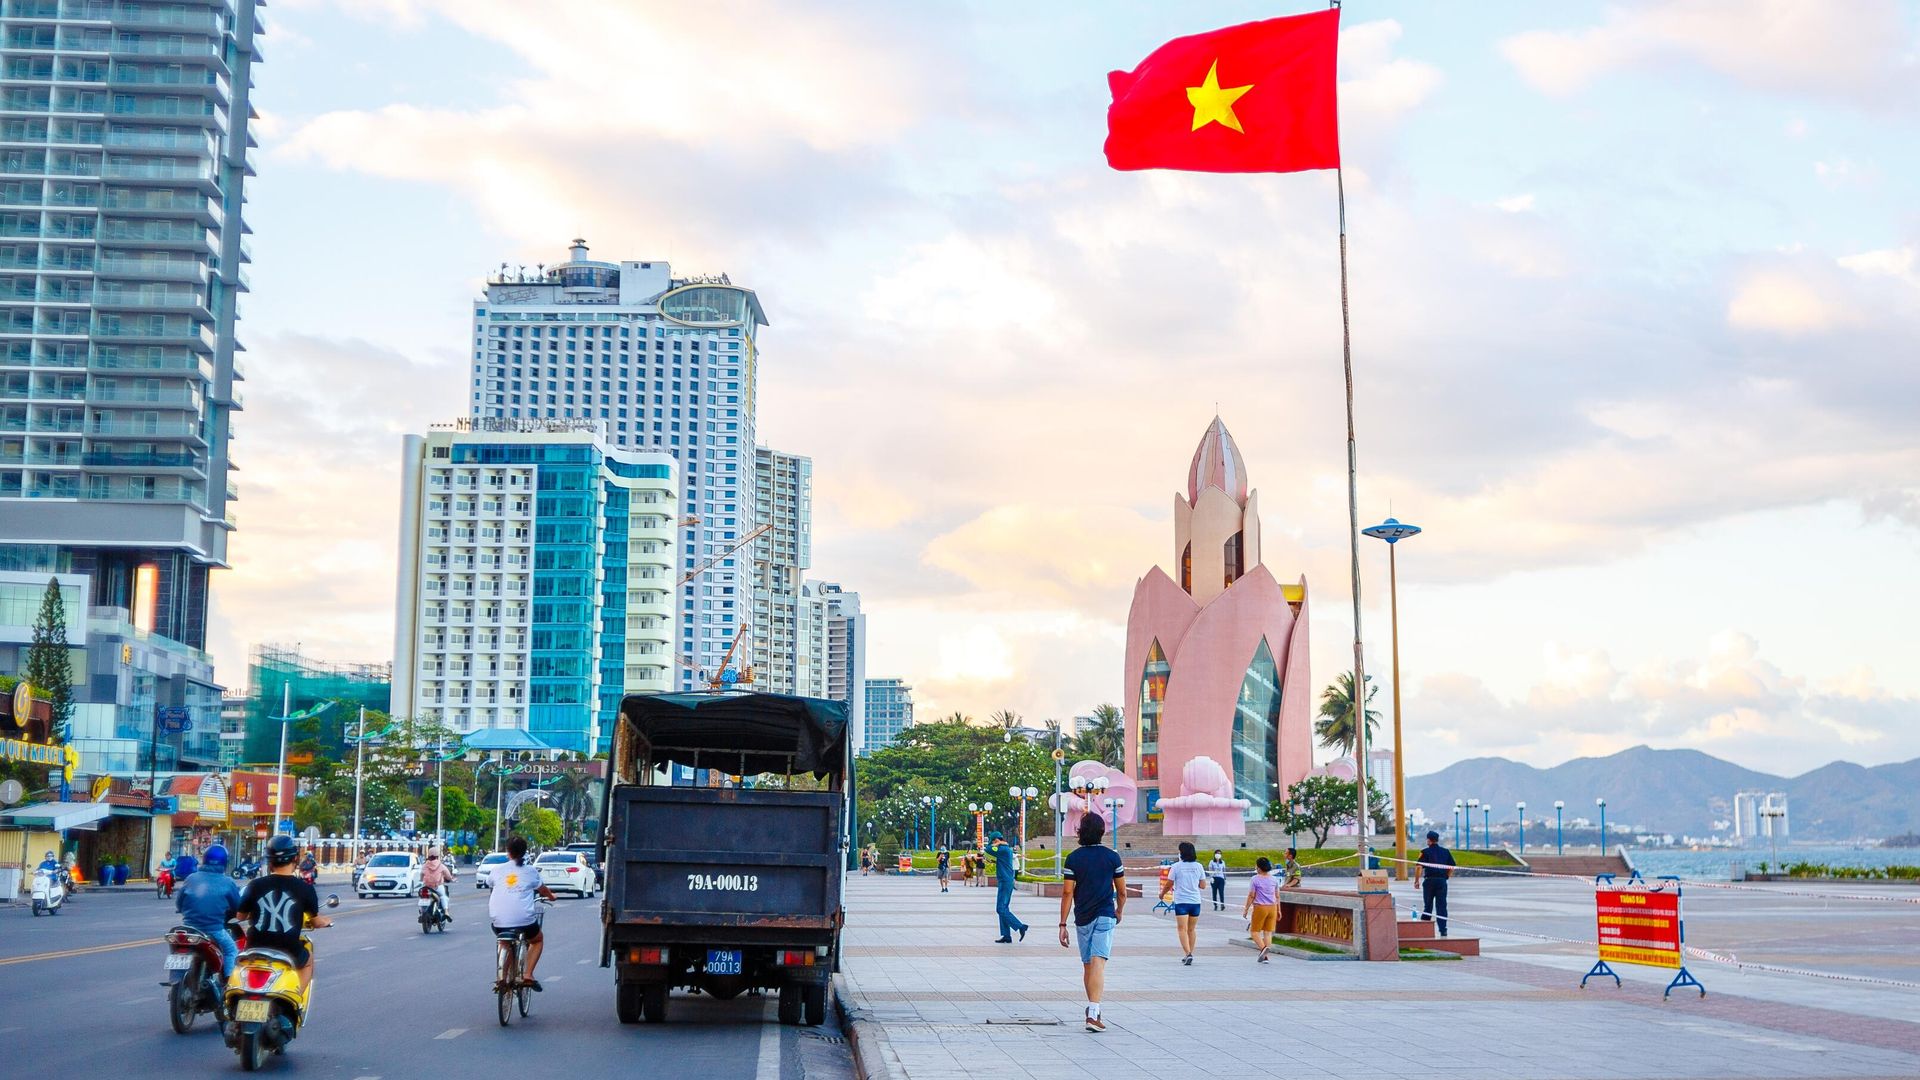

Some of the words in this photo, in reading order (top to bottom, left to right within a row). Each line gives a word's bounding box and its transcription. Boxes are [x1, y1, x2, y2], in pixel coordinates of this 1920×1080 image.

[687, 874, 758, 891] 79A-000.13
[715, 951, 733, 961] 79A
[708, 962, 740, 973] 000.13
